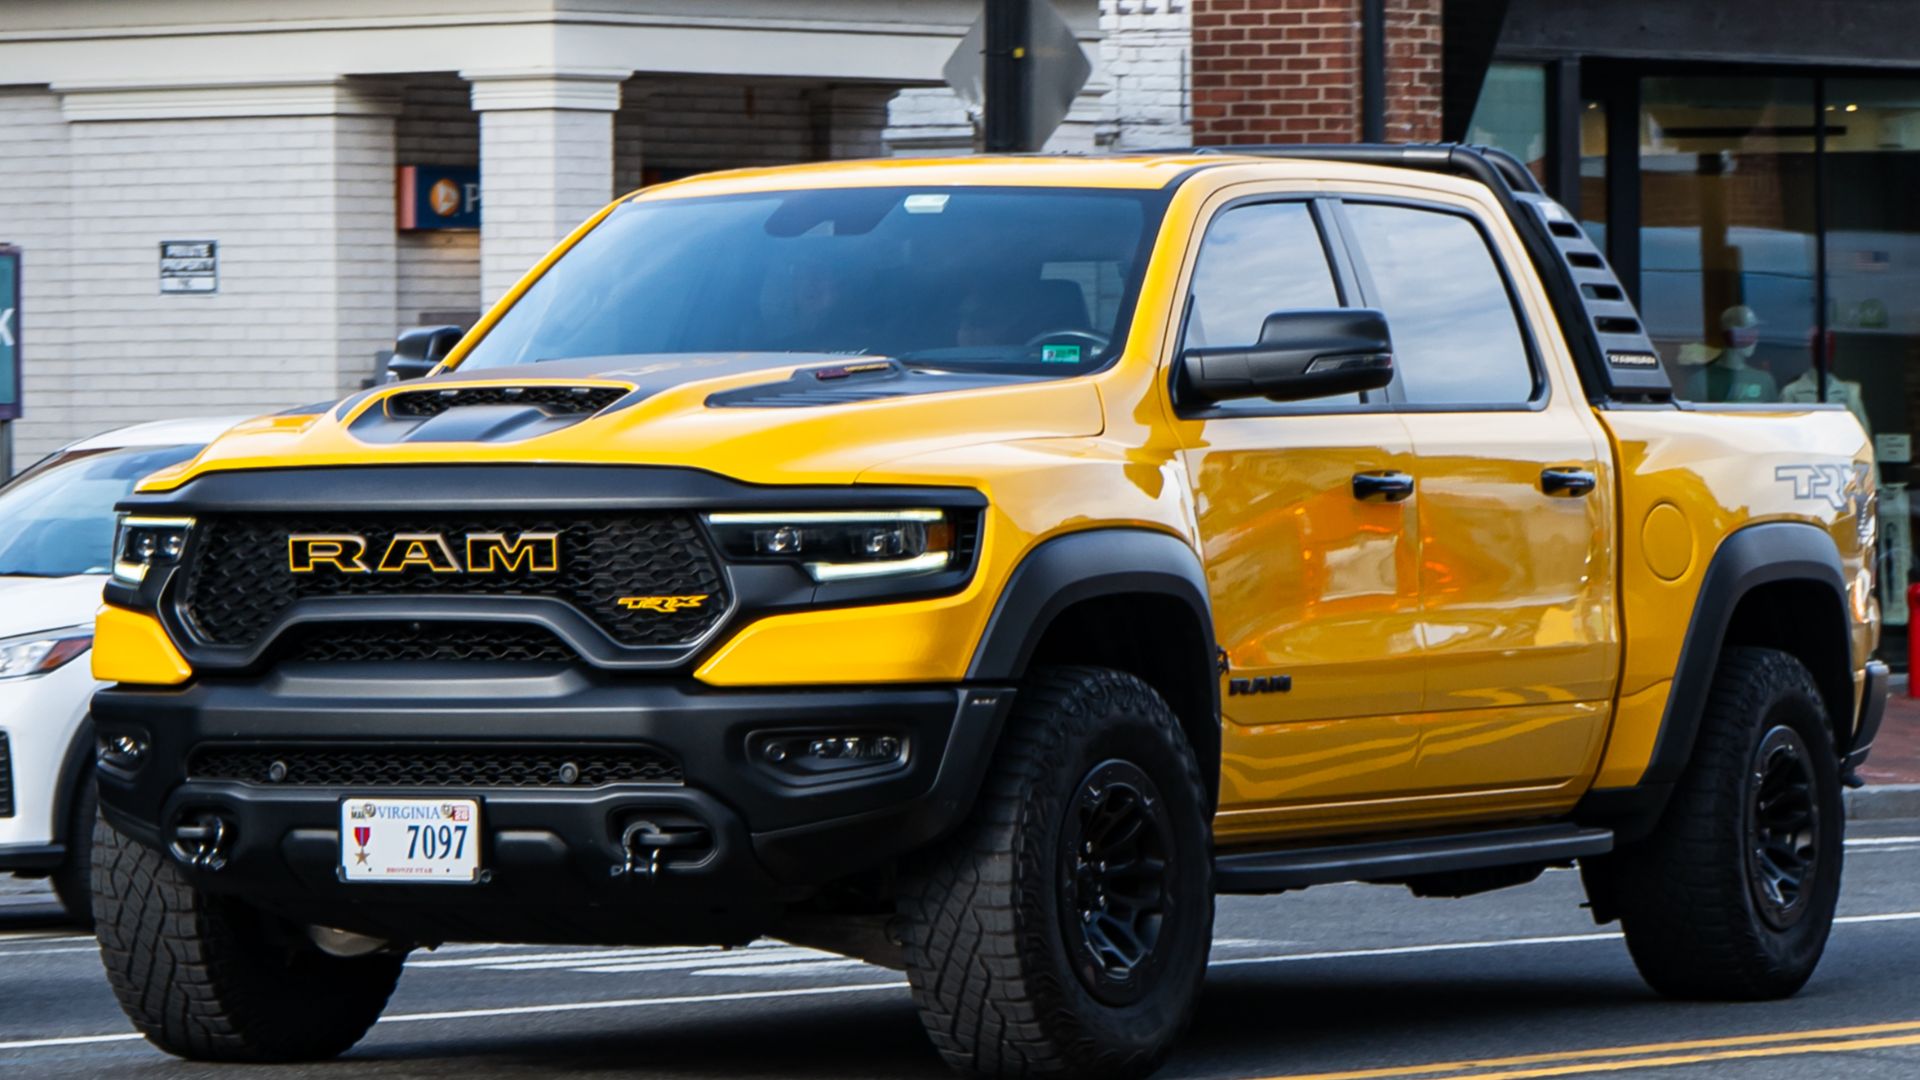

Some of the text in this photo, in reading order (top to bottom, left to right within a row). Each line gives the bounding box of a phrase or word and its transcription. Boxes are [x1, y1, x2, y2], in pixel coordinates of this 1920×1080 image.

[288, 533, 559, 573] RAM
[617, 594, 709, 612] TRX
[1228, 674, 1292, 697] RAM
[378, 805, 440, 819] VIRGINIA
[406, 825, 468, 860] 7097
